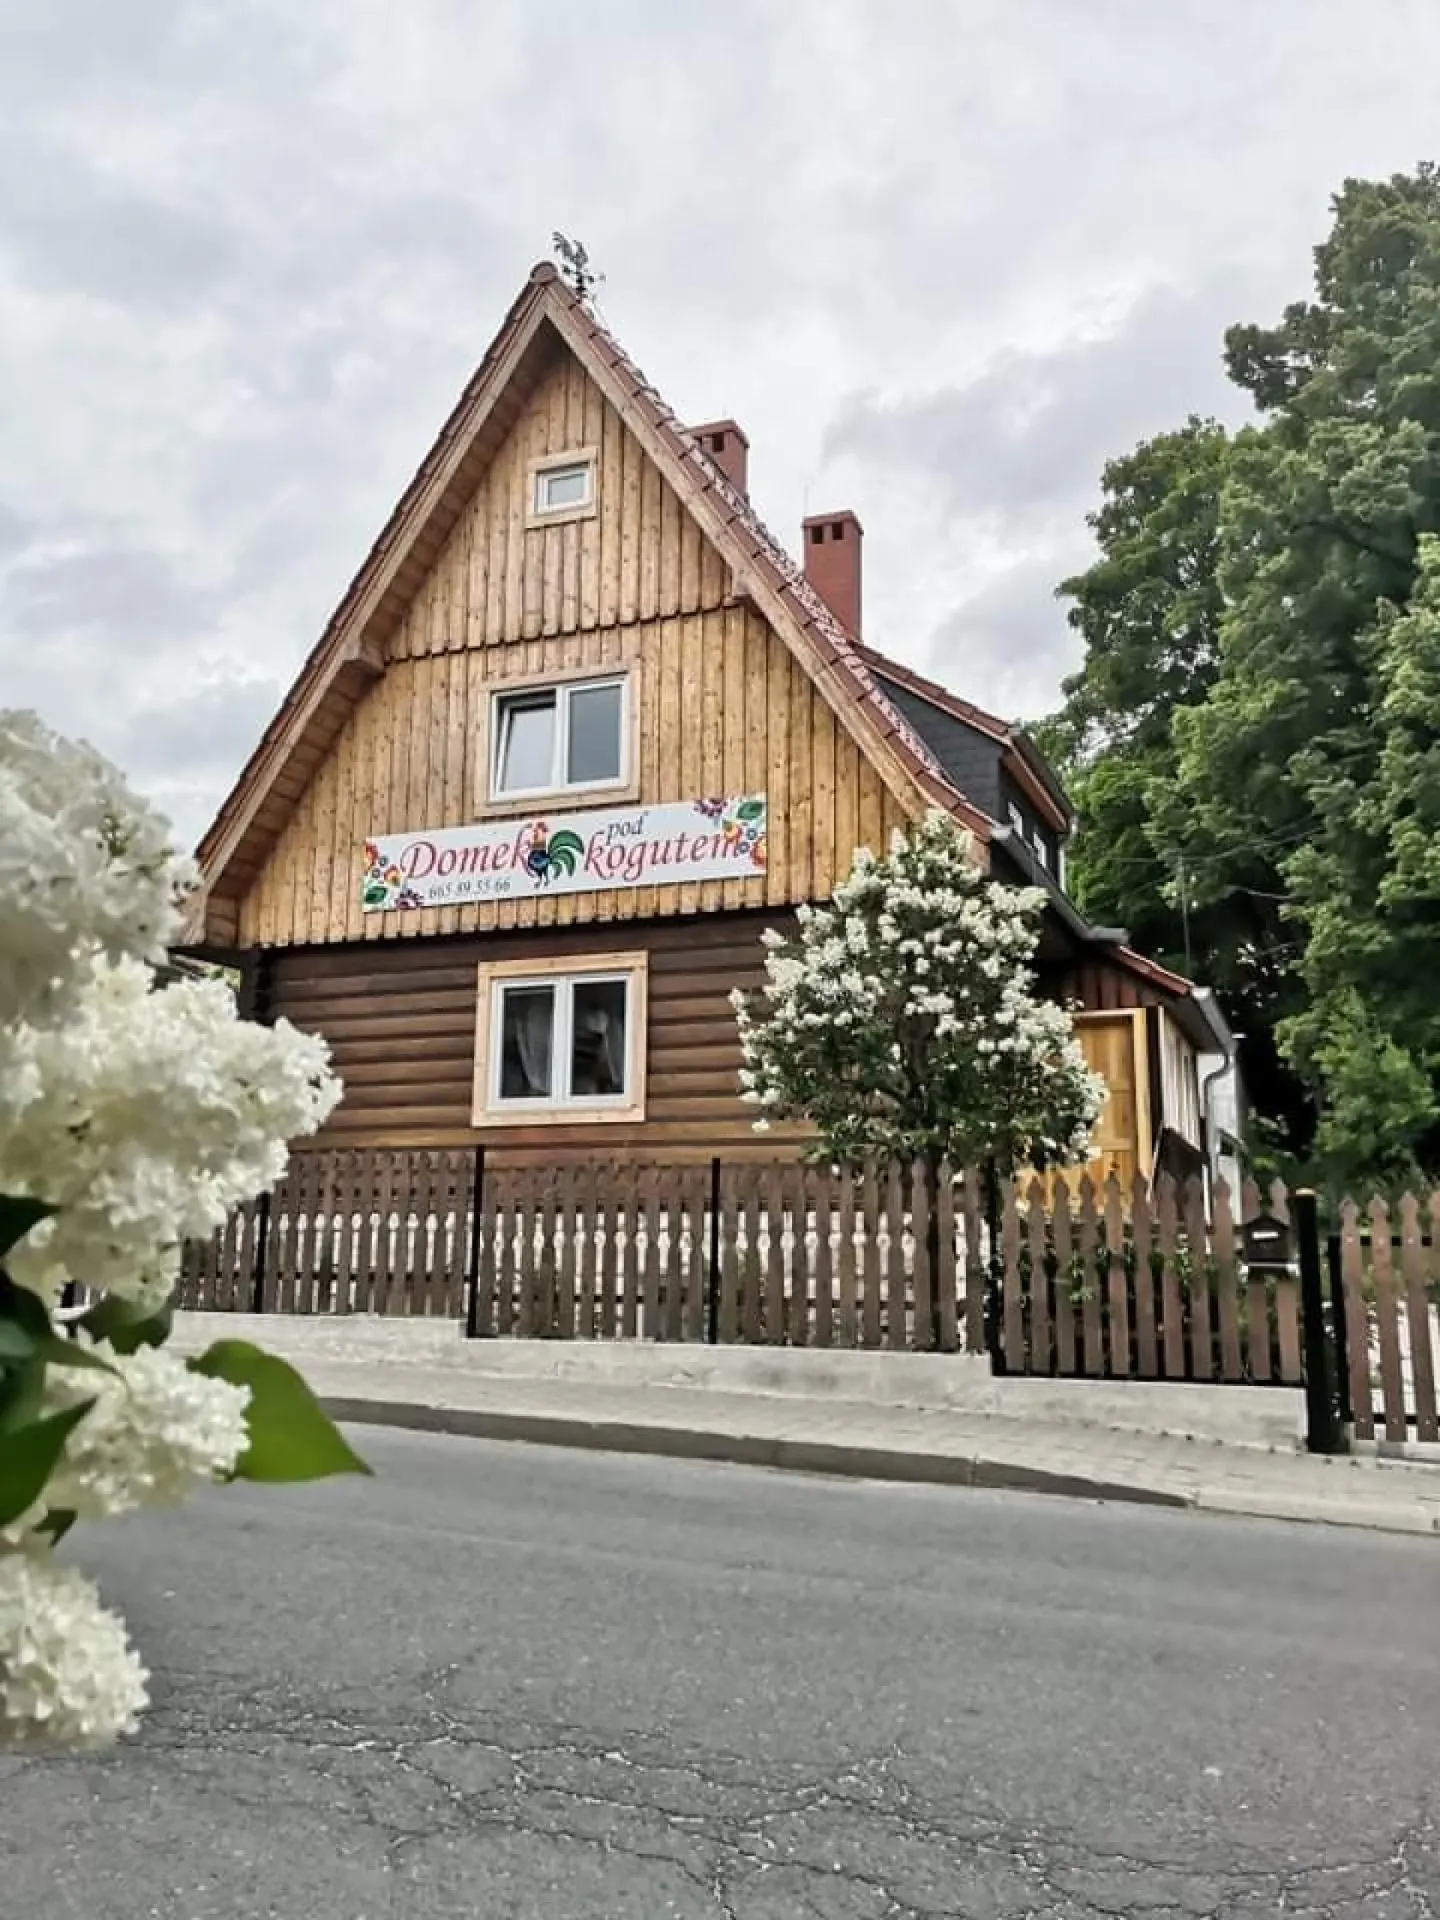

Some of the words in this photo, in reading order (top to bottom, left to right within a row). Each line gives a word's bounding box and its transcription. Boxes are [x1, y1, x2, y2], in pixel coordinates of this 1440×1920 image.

[400, 822, 535, 878] Domek
[606, 810, 648, 846] pod
[584, 830, 739, 881] kogutem
